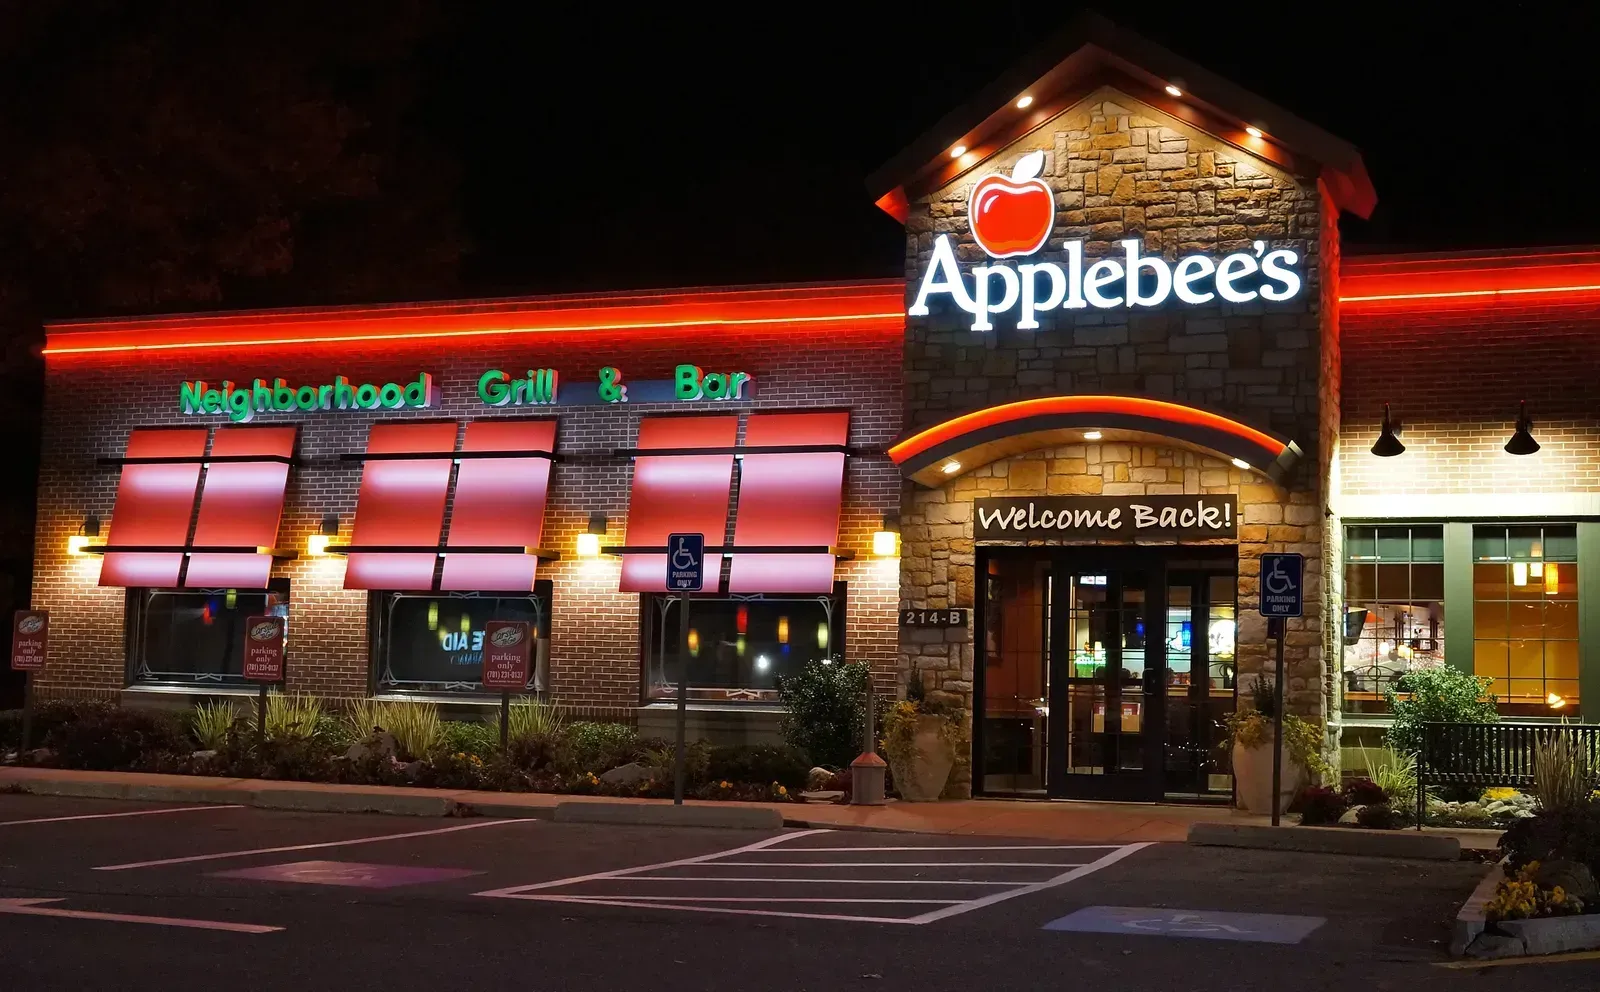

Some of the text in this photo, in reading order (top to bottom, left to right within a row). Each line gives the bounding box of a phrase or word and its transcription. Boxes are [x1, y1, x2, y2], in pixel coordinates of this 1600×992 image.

[908, 233, 1301, 331] Applebee's
[179, 364, 752, 422] Neighborhood Grill & Bar
[978, 500, 1232, 531] Welcome Back!
[677, 579, 692, 587] ONLY
[1266, 595, 1296, 603] PARKING
[1272, 604, 1290, 612] ONLY
[906, 611, 960, 624] 214-B
[18, 639, 42, 649] parking
[22, 647, 37, 656] only
[251, 646, 278, 657] parking
[256, 655, 271, 664] only
[491, 652, 521, 664] parking
[497, 661, 514, 671] only
